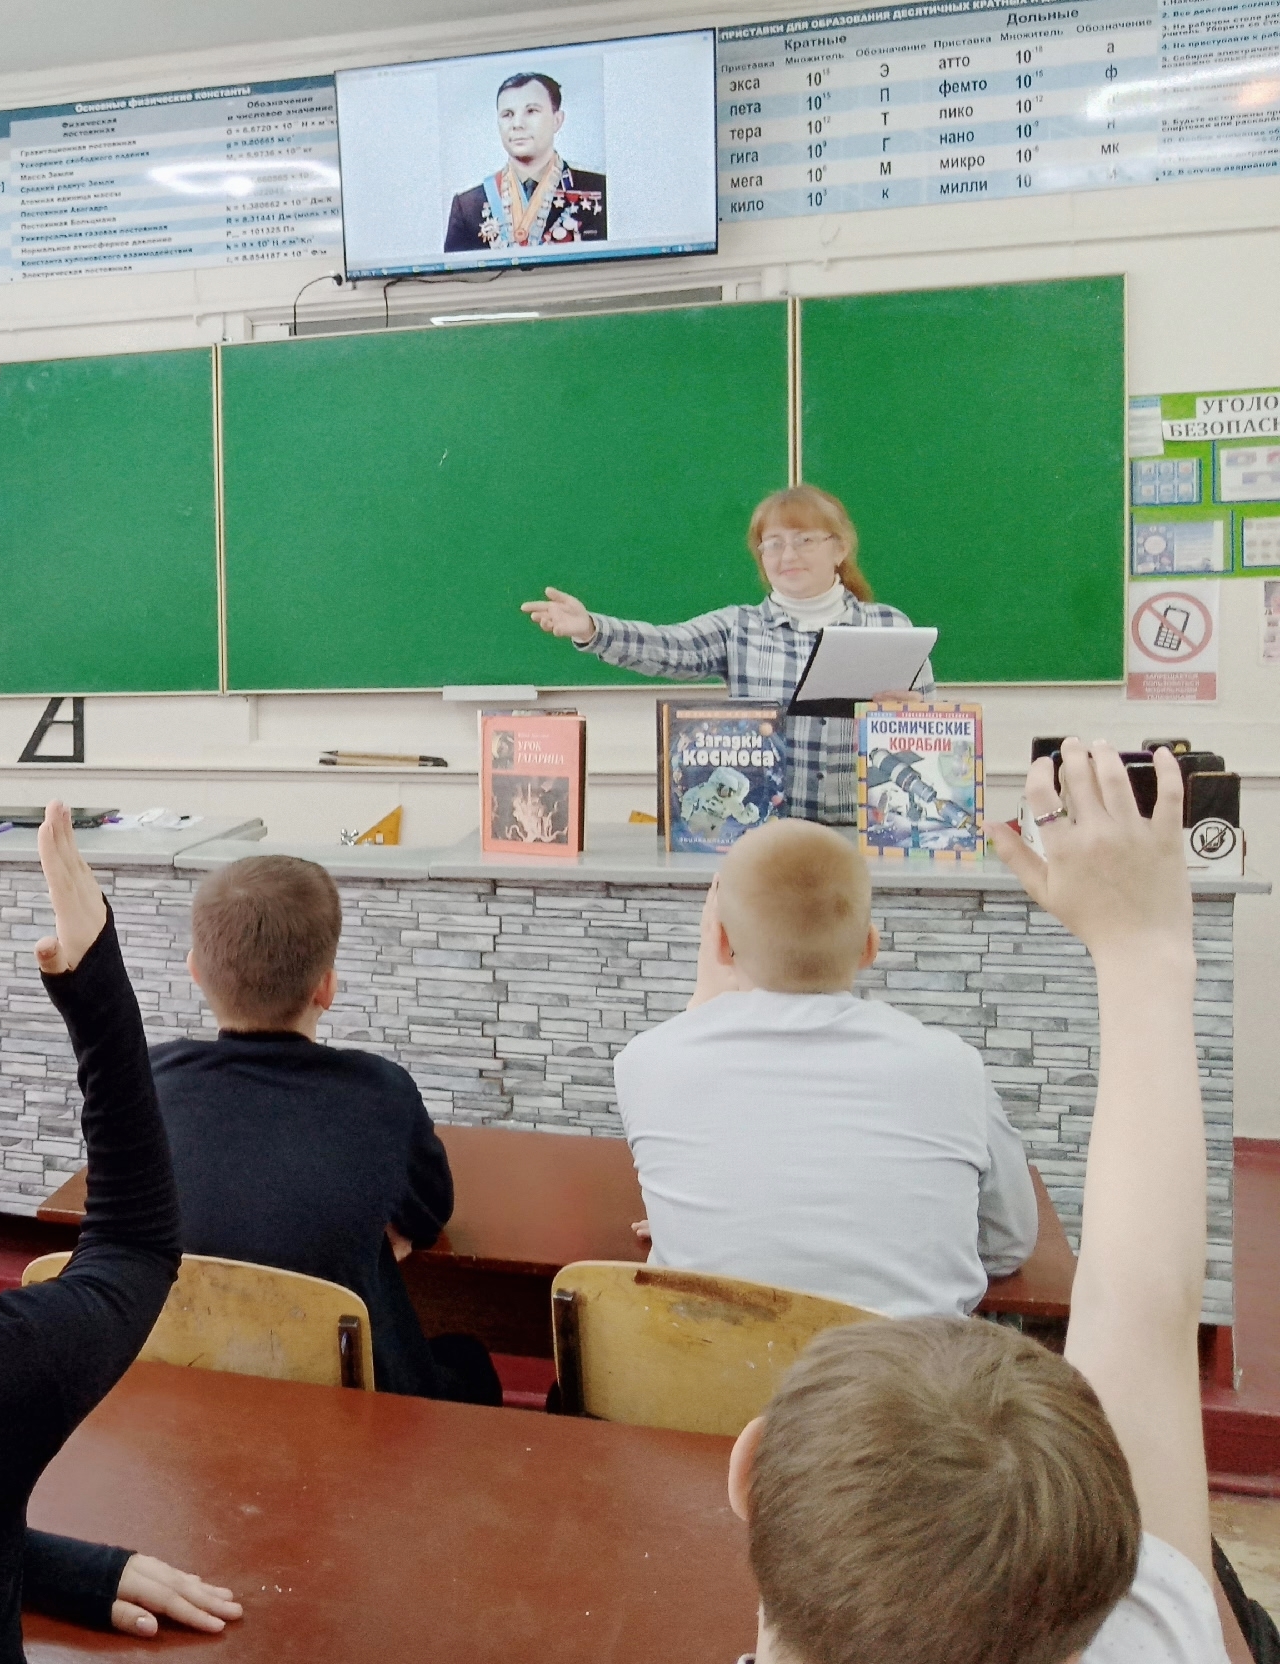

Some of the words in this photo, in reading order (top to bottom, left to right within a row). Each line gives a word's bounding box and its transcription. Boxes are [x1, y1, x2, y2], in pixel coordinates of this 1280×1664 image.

[721, 25, 784, 40] ПРИСТАВКИ
[786, 22, 808, 32] ДЛЯ
[812, 11, 890, 28] ОБРАЗОВАНИЯ
[893, 1, 970, 19] ДЕСЯТИЧНЫХ
[1006, 9, 1079, 27] Дольные
[784, 35, 847, 51] Кратные
[934, 36, 992, 50] Приставка
[1000, 29, 1064, 42] Множитель
[1076, 19, 1152, 33] Обозначение
[721, 60, 775, 73] Приставка
[785, 53, 844, 65] Множитель
[855, 43, 926, 57] Обозначение
[729, 78, 760, 92] экса
[939, 56, 970, 70] атто
[75, 100, 126, 113] Основные
[128, 92, 192, 109] физические
[195, 86, 251, 101] константы
[246, 96, 313, 108] Обозначение
[730, 102, 761, 116] пета
[939, 79, 988, 98] фемто
[285, 105, 333, 115] значение
[729, 126, 762, 142] тера
[939, 106, 973, 119] пико
[730, 150, 759, 164] гига
[939, 131, 974, 145] нано
[730, 175, 763, 188] мега
[940, 155, 985, 171] микро
[730, 200, 764, 213] кило
[940, 180, 988, 194] милли
[1203, 396, 1279, 415] УГОЛО
[871, 720, 971, 735] КОСМИЧЕСКИЕ
[517, 741, 541, 751] УРОК
[695, 732, 762, 750] Загадки
[889, 737, 952, 752] КОРАБЛИ
[517, 753, 565, 764] ГАГАРИНА
